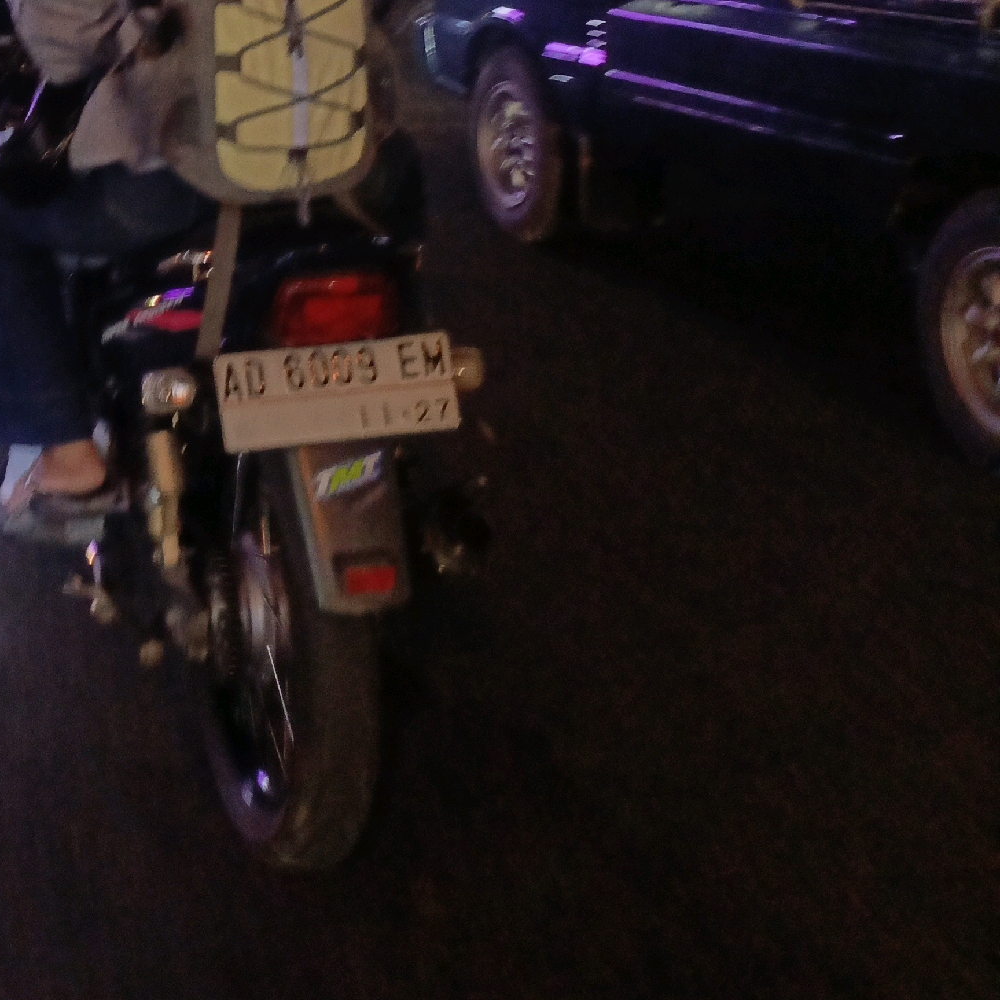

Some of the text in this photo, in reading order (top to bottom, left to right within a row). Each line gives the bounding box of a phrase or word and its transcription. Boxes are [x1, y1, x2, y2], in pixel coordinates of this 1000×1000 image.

[223, 339, 447, 403] AD 6009 EM
